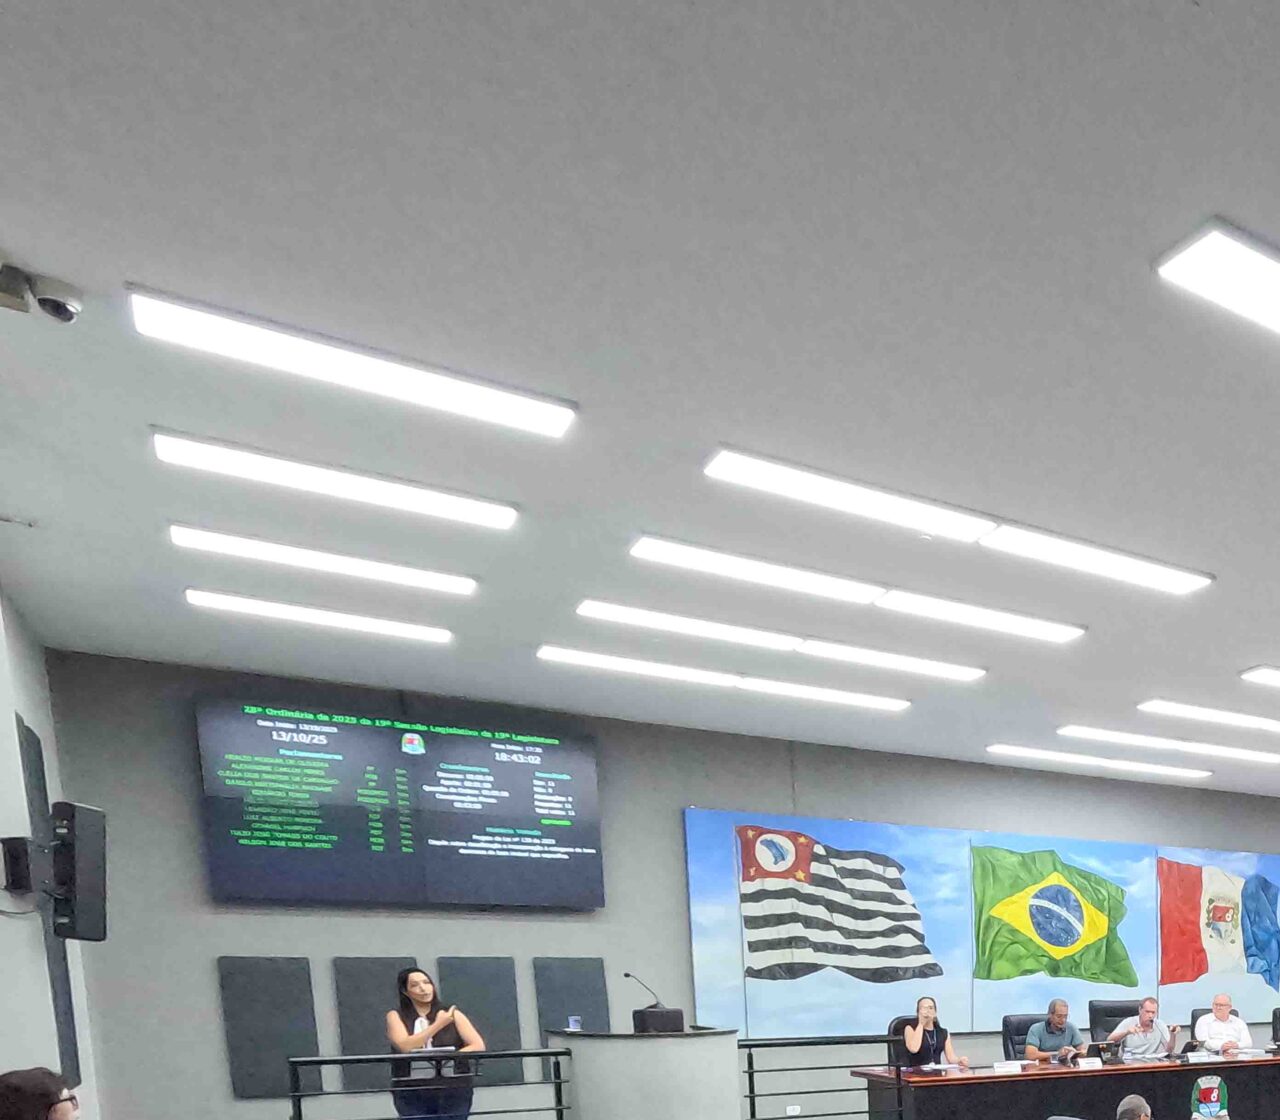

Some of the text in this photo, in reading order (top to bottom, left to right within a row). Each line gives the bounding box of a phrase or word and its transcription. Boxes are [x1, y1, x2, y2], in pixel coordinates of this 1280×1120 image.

[266, 708, 314, 720] Ordinária
[332, 714, 357, 724] 2025
[271, 731, 328, 745] 13/10/25
[494, 752, 542, 765] 18:43:02
